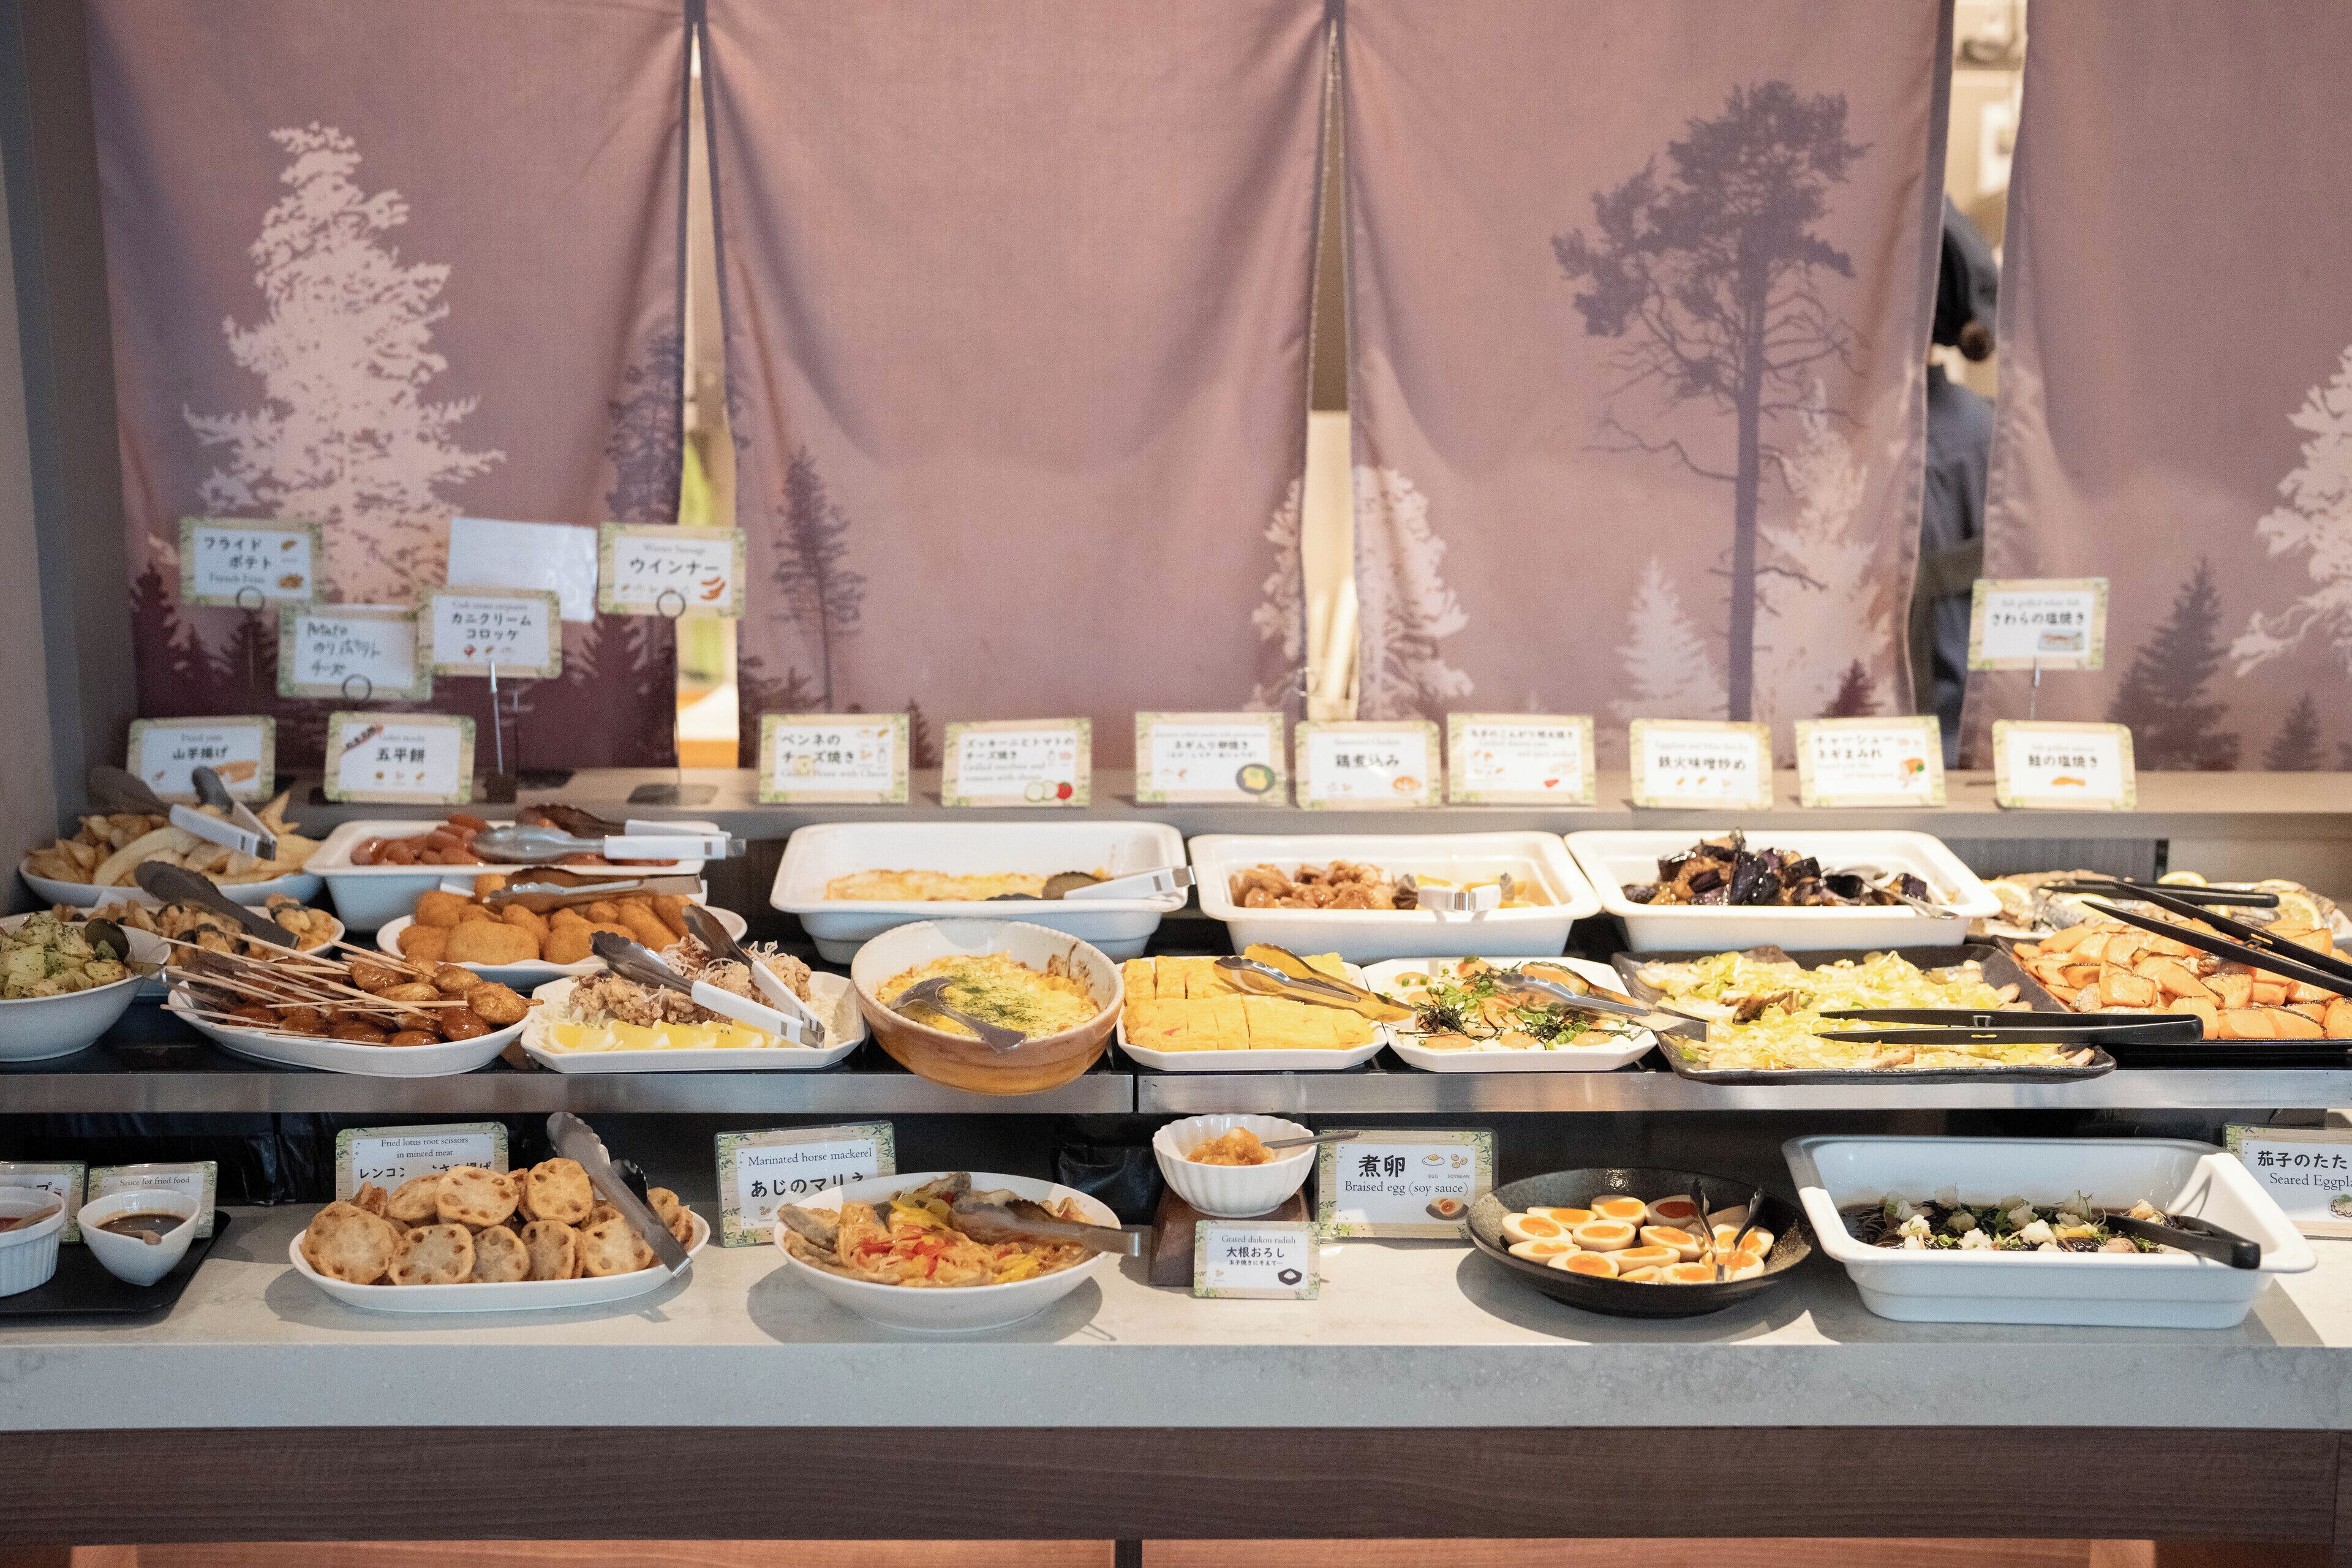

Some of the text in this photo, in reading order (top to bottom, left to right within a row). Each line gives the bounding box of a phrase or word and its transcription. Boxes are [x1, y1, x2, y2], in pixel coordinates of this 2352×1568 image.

[203, 536, 263, 551] フライド
[630, 557, 720, 576] ウインナー
[452, 612, 532, 626] カニクリーム
[467, 628, 518, 641] コロッケ
[782, 734, 841, 747] ペンネの
[2029, 754, 2097, 769] 鮭の塩焼き
[748, 1147, 872, 1166] Marinated horse mackerel
[2258, 1151, 2347, 1169] 茄子のたた
[1359, 1154, 1406, 1178] 煮卵
[2270, 1172, 2309, 1185] Seared
[1345, 1181, 1469, 1196] Braised egg (soy sauce)
[1226, 1246, 1284, 1258] 大根おろし
